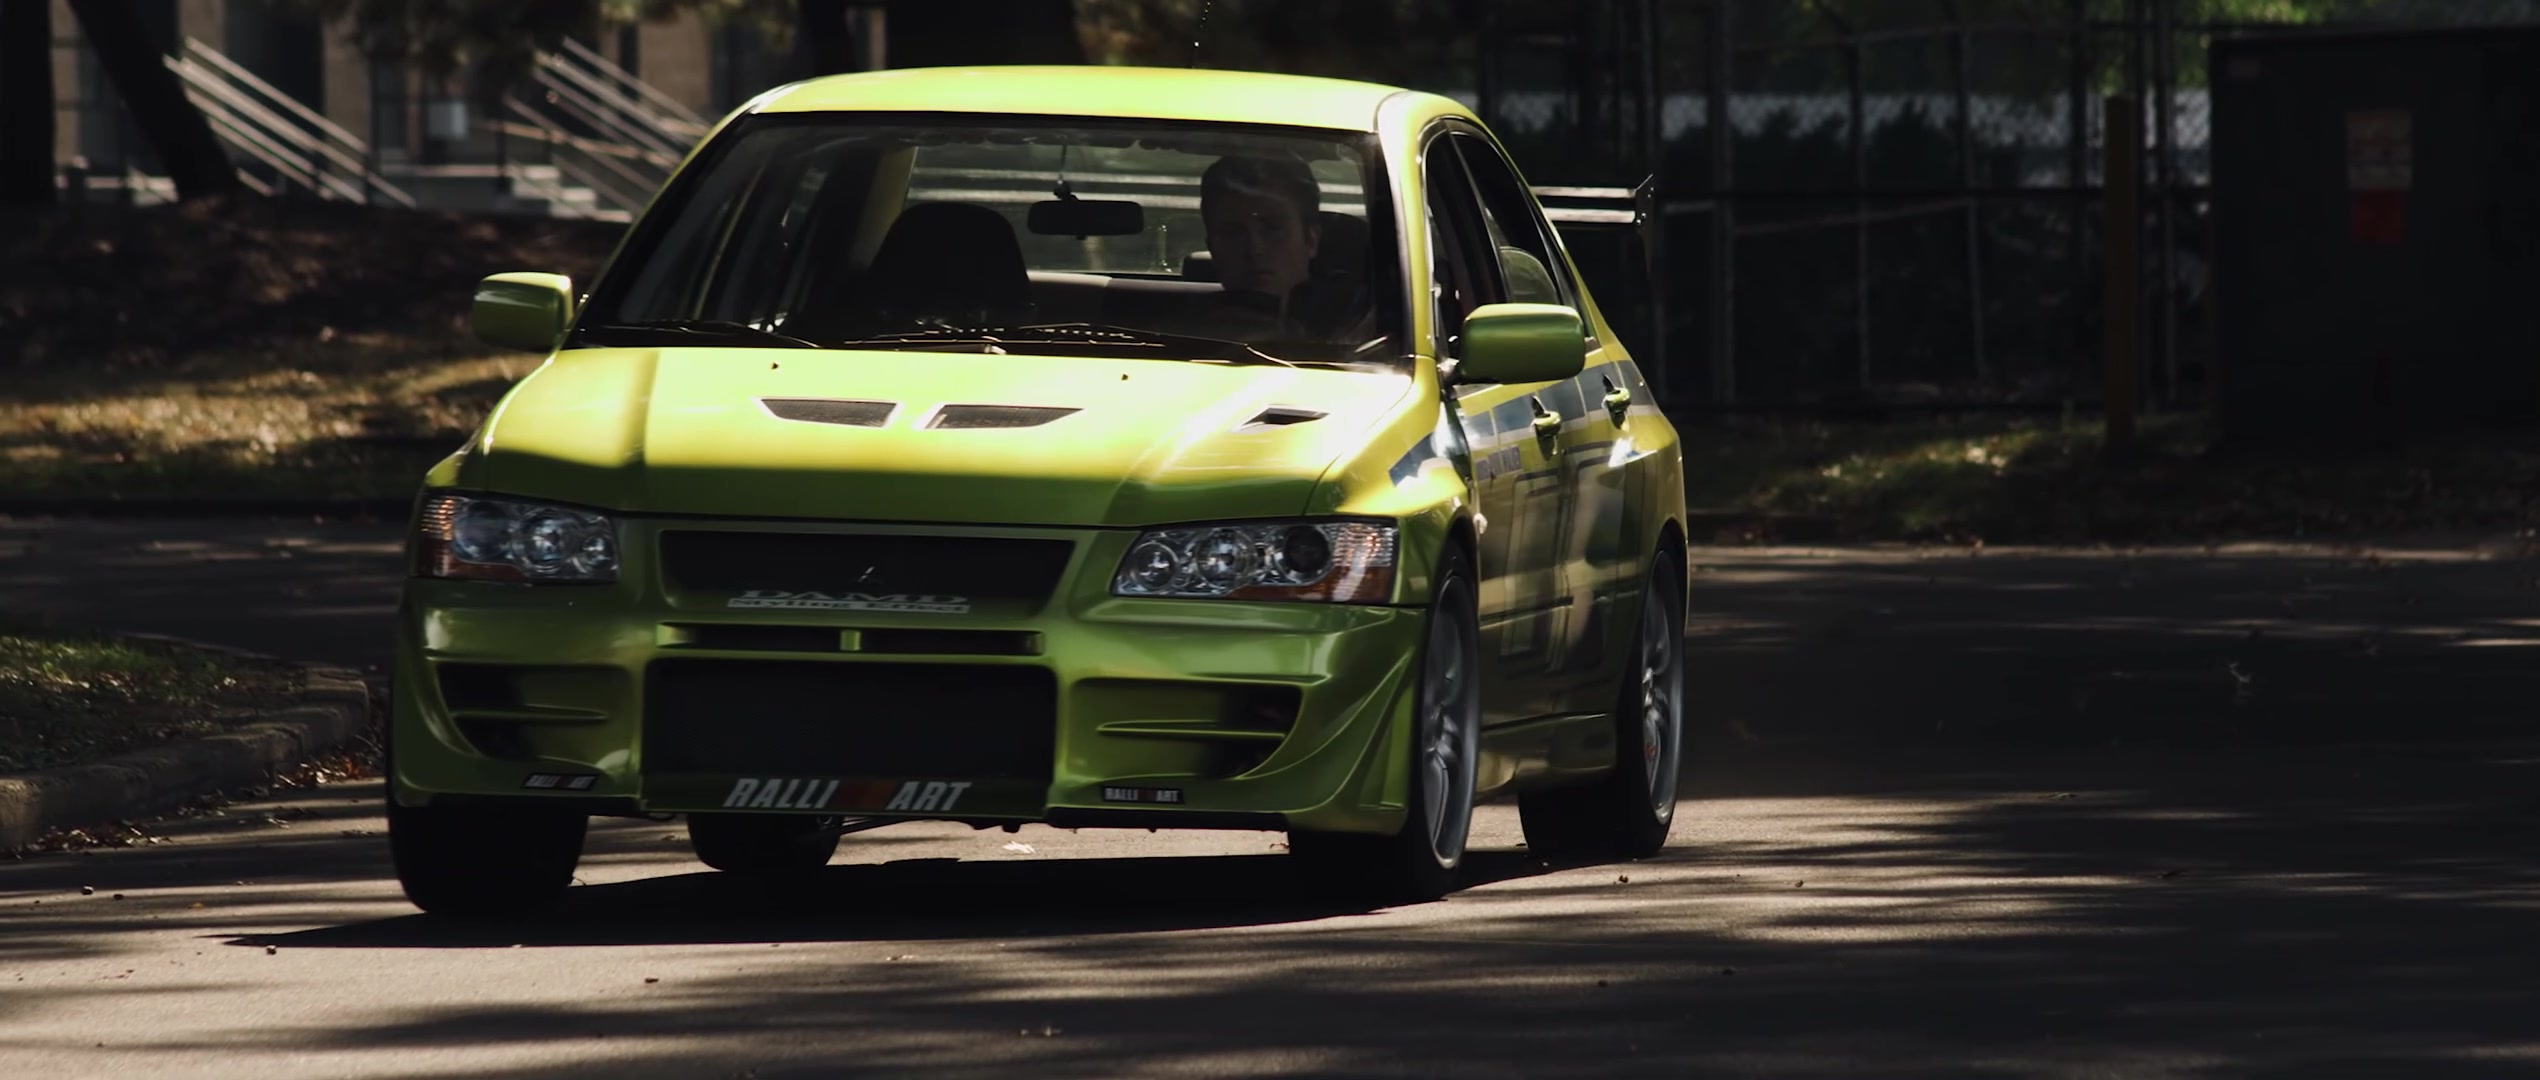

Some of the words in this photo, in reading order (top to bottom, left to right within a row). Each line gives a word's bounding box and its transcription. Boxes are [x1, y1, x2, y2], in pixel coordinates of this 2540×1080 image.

[740, 589, 968, 604] DAMD
[722, 778, 840, 809] RALLI
[885, 781, 972, 811] ART
[1104, 788, 1139, 800] RALLI
